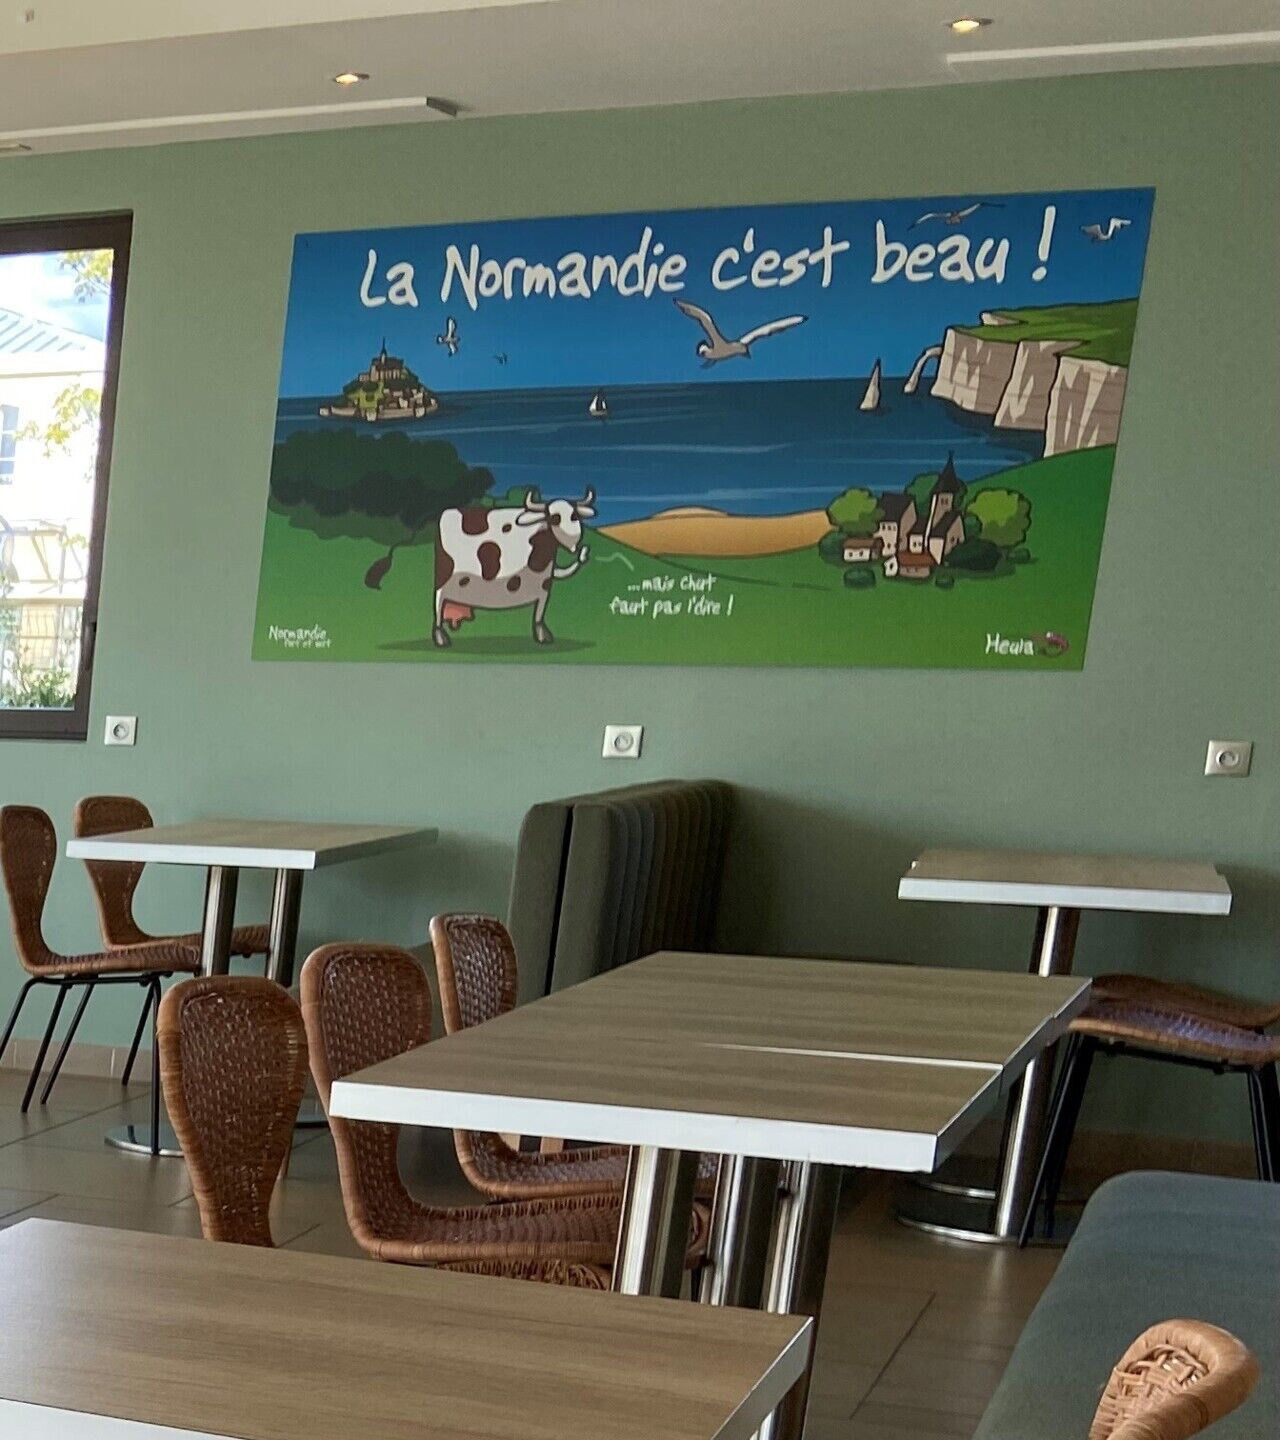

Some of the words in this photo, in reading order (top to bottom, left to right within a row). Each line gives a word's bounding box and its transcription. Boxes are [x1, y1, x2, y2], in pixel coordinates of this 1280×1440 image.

[359, 249, 419, 309] La
[440, 225, 688, 312] Normandie
[711, 226, 851, 292] c'est
[870, 218, 1011, 285] beau
[679, 572, 718, 592] chut
[609, 595, 649, 616] faut
[652, 599, 682, 620] pas
[985, 631, 1034, 656] Heula
